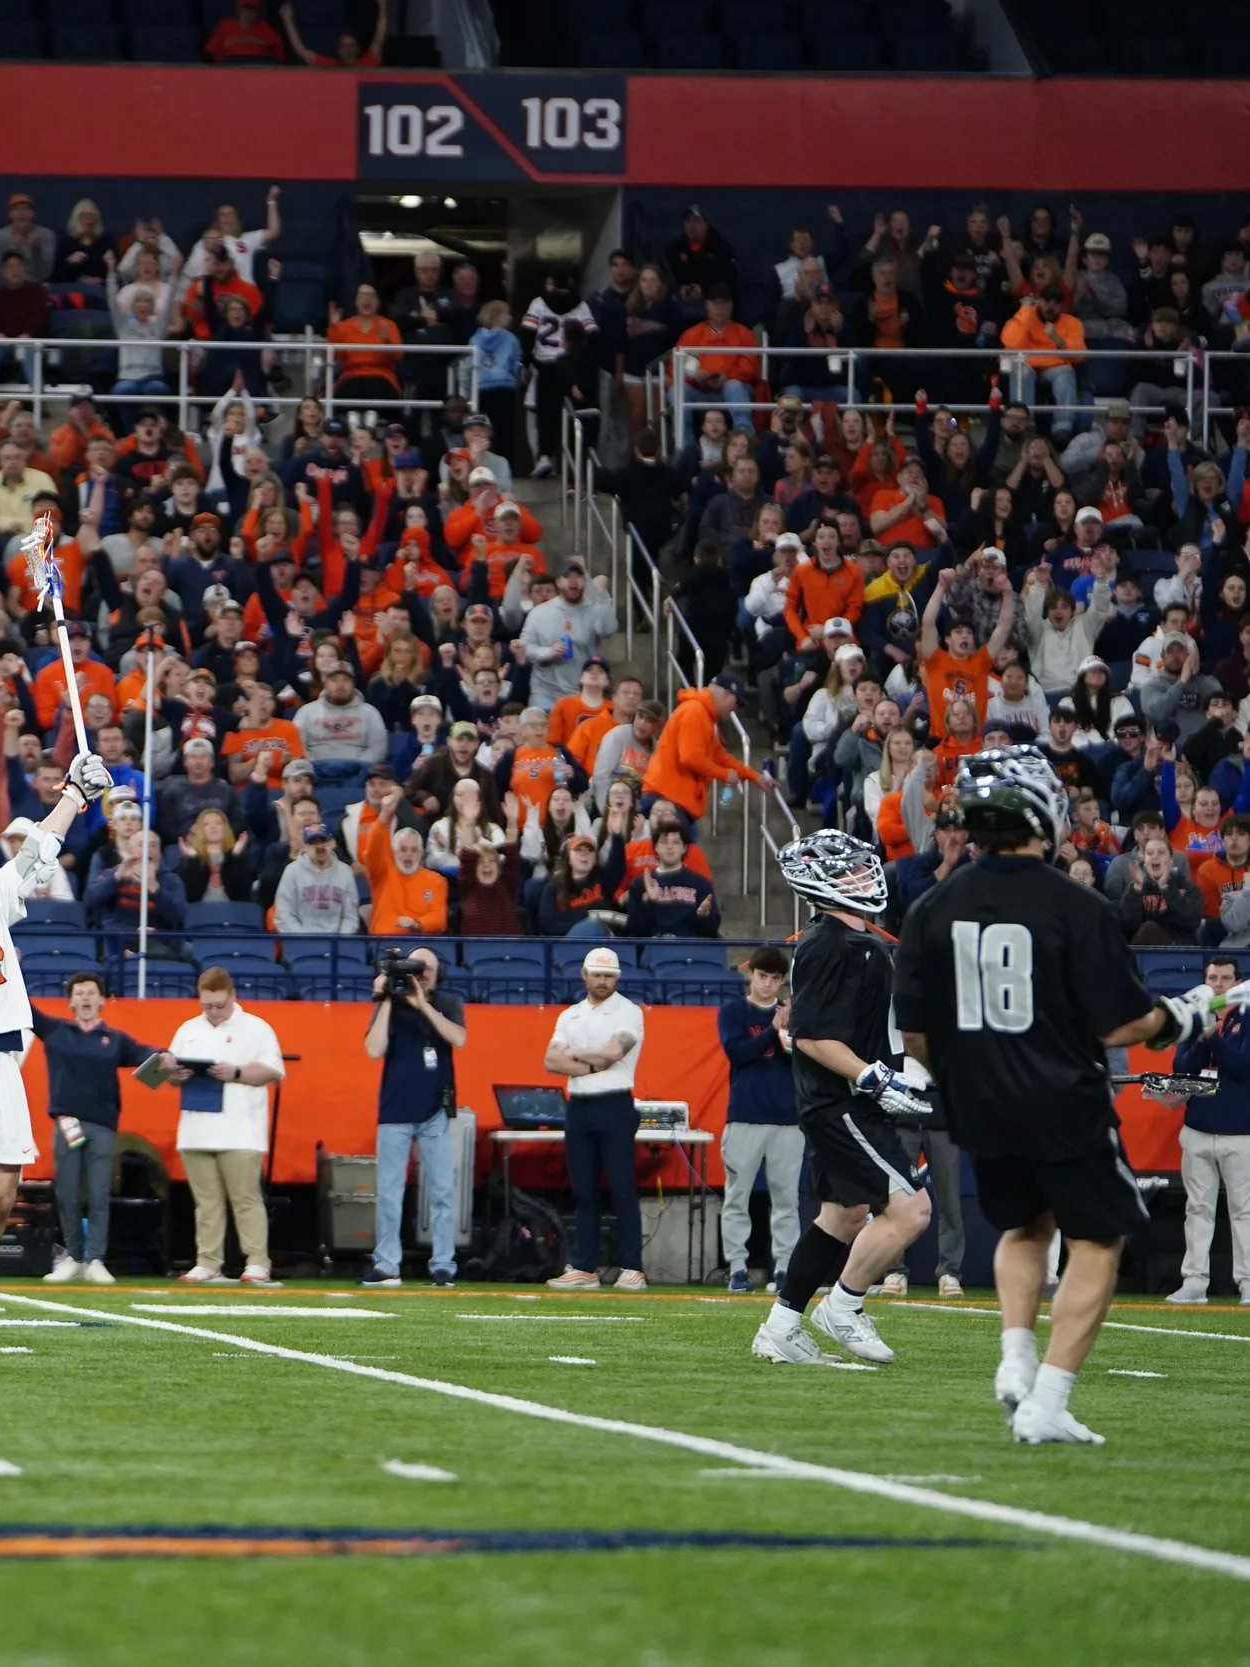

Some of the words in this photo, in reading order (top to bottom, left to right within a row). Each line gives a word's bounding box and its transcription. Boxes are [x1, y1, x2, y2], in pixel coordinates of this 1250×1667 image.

[364, 104, 464, 157] 102
[522, 97, 621, 150] 103
[952, 920, 1034, 1032] 18
